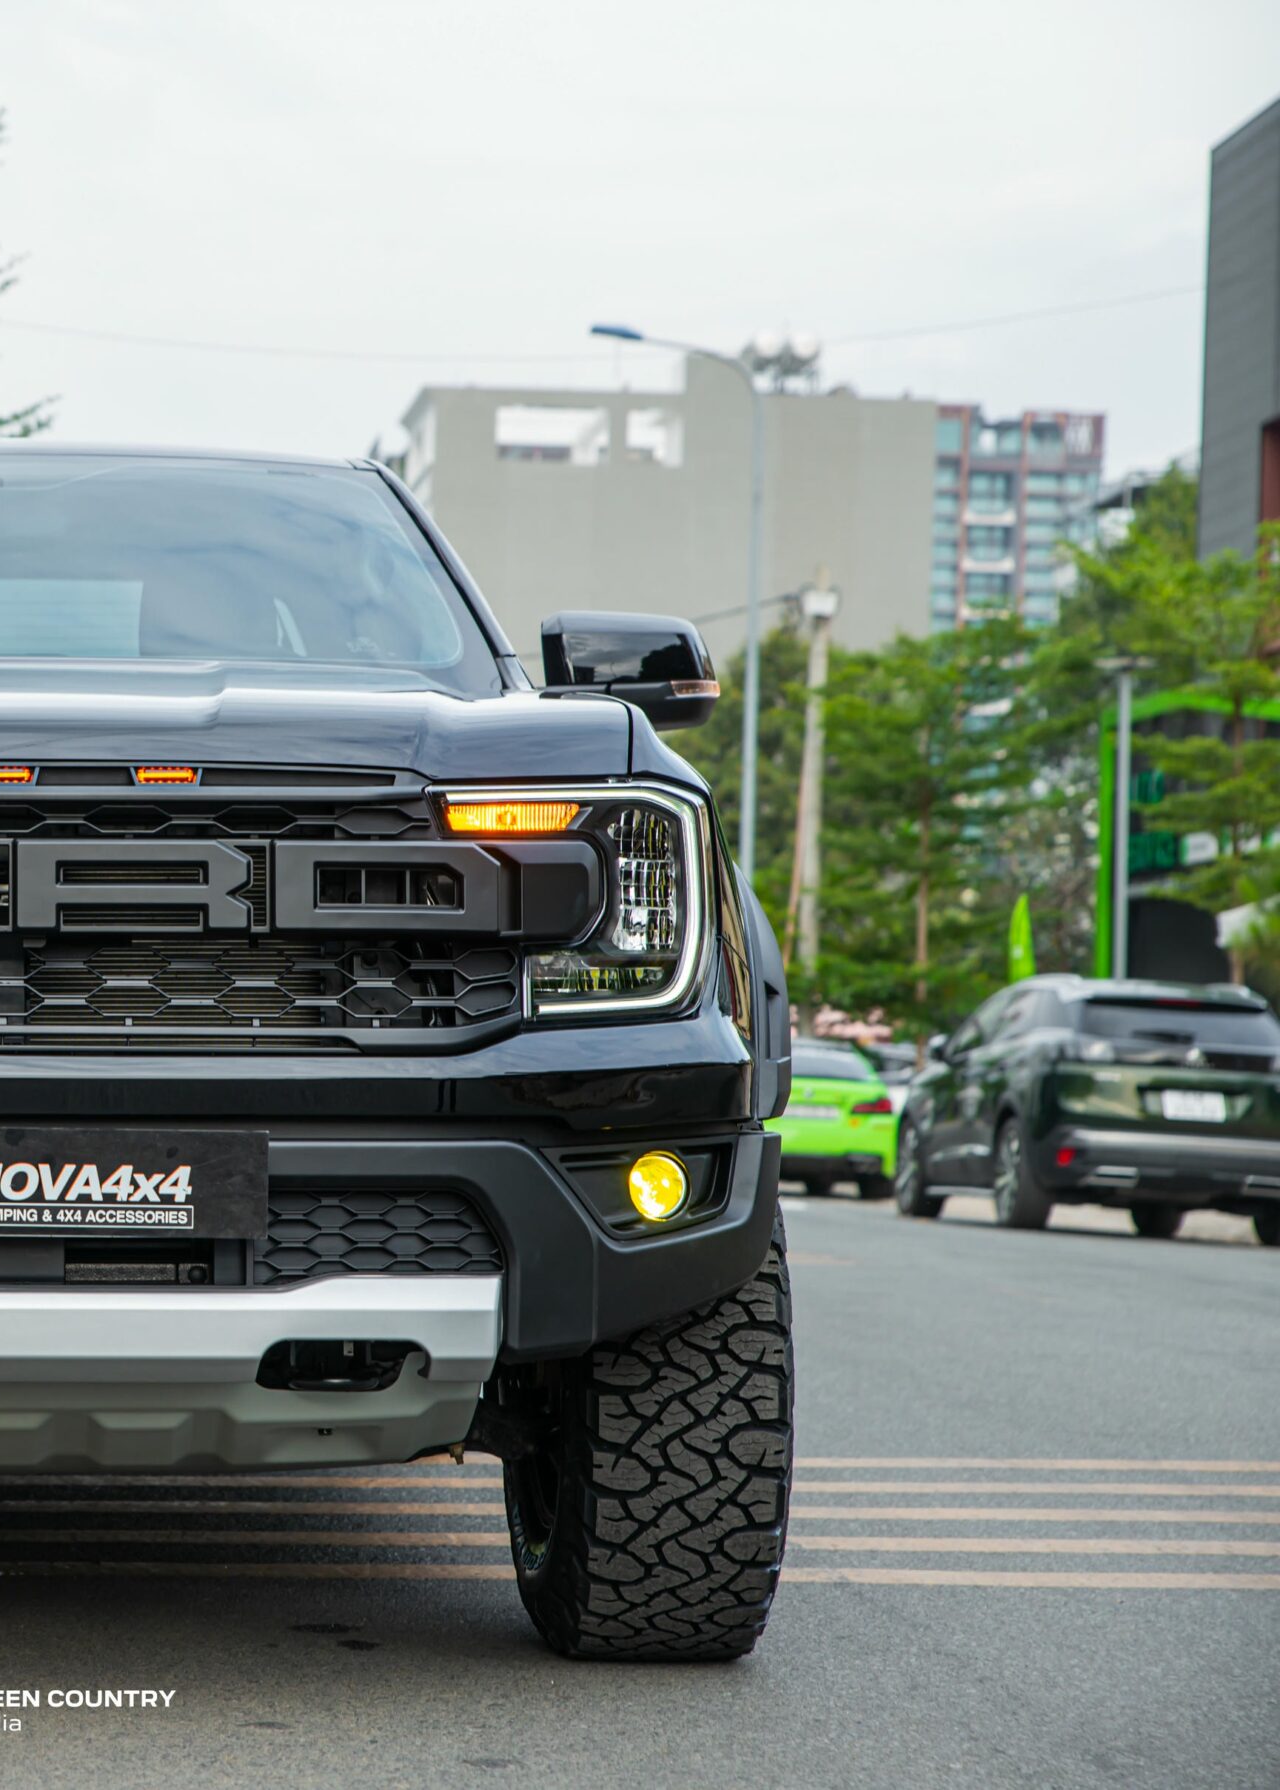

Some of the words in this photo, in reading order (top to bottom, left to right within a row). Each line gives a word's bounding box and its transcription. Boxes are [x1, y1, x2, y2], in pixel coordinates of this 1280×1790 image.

[42, 1208, 53, 1222] &
[56, 1209, 82, 1223] 4X4
[85, 1209, 188, 1225] ACCESSORIES
